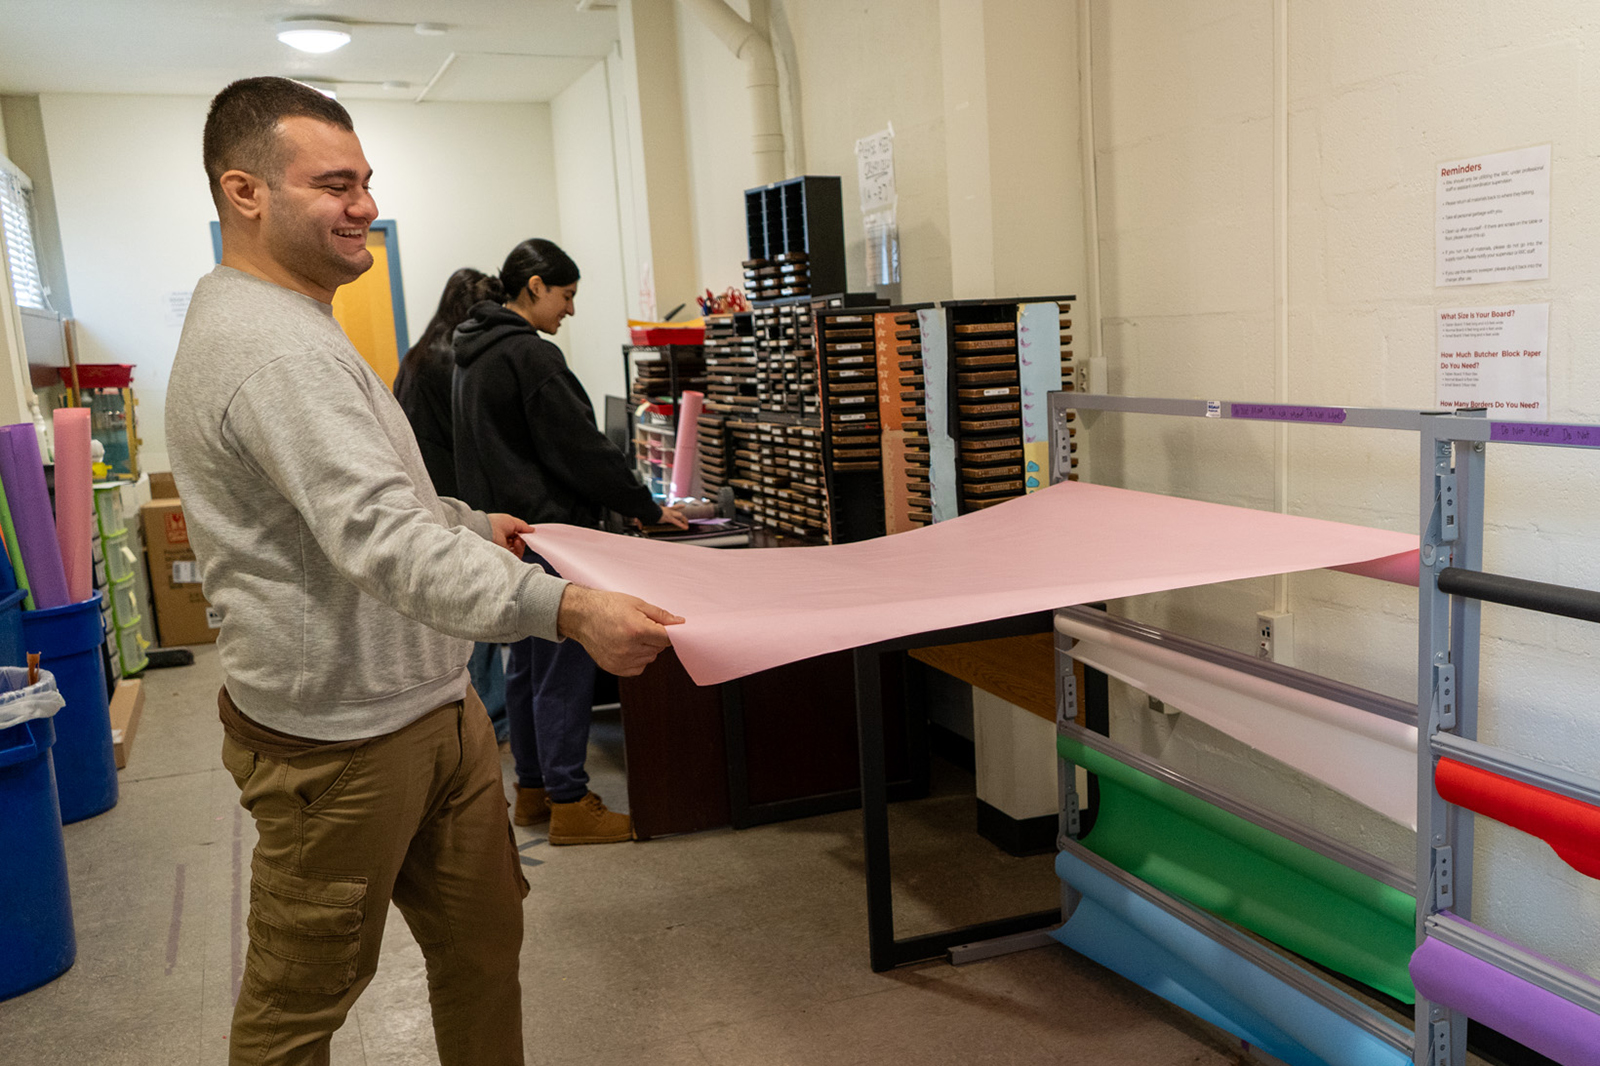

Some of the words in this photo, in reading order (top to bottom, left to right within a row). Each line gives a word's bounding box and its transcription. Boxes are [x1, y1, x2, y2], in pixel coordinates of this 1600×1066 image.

[1441, 164, 1482, 177] Reminders
[1491, 310, 1516, 318] Board?
[1523, 350, 1542, 358] Paper
[1501, 424, 1509, 435] Do
[1512, 426, 1525, 436] Not
[1562, 428, 1572, 440] Do
[1577, 430, 1590, 440] Not
